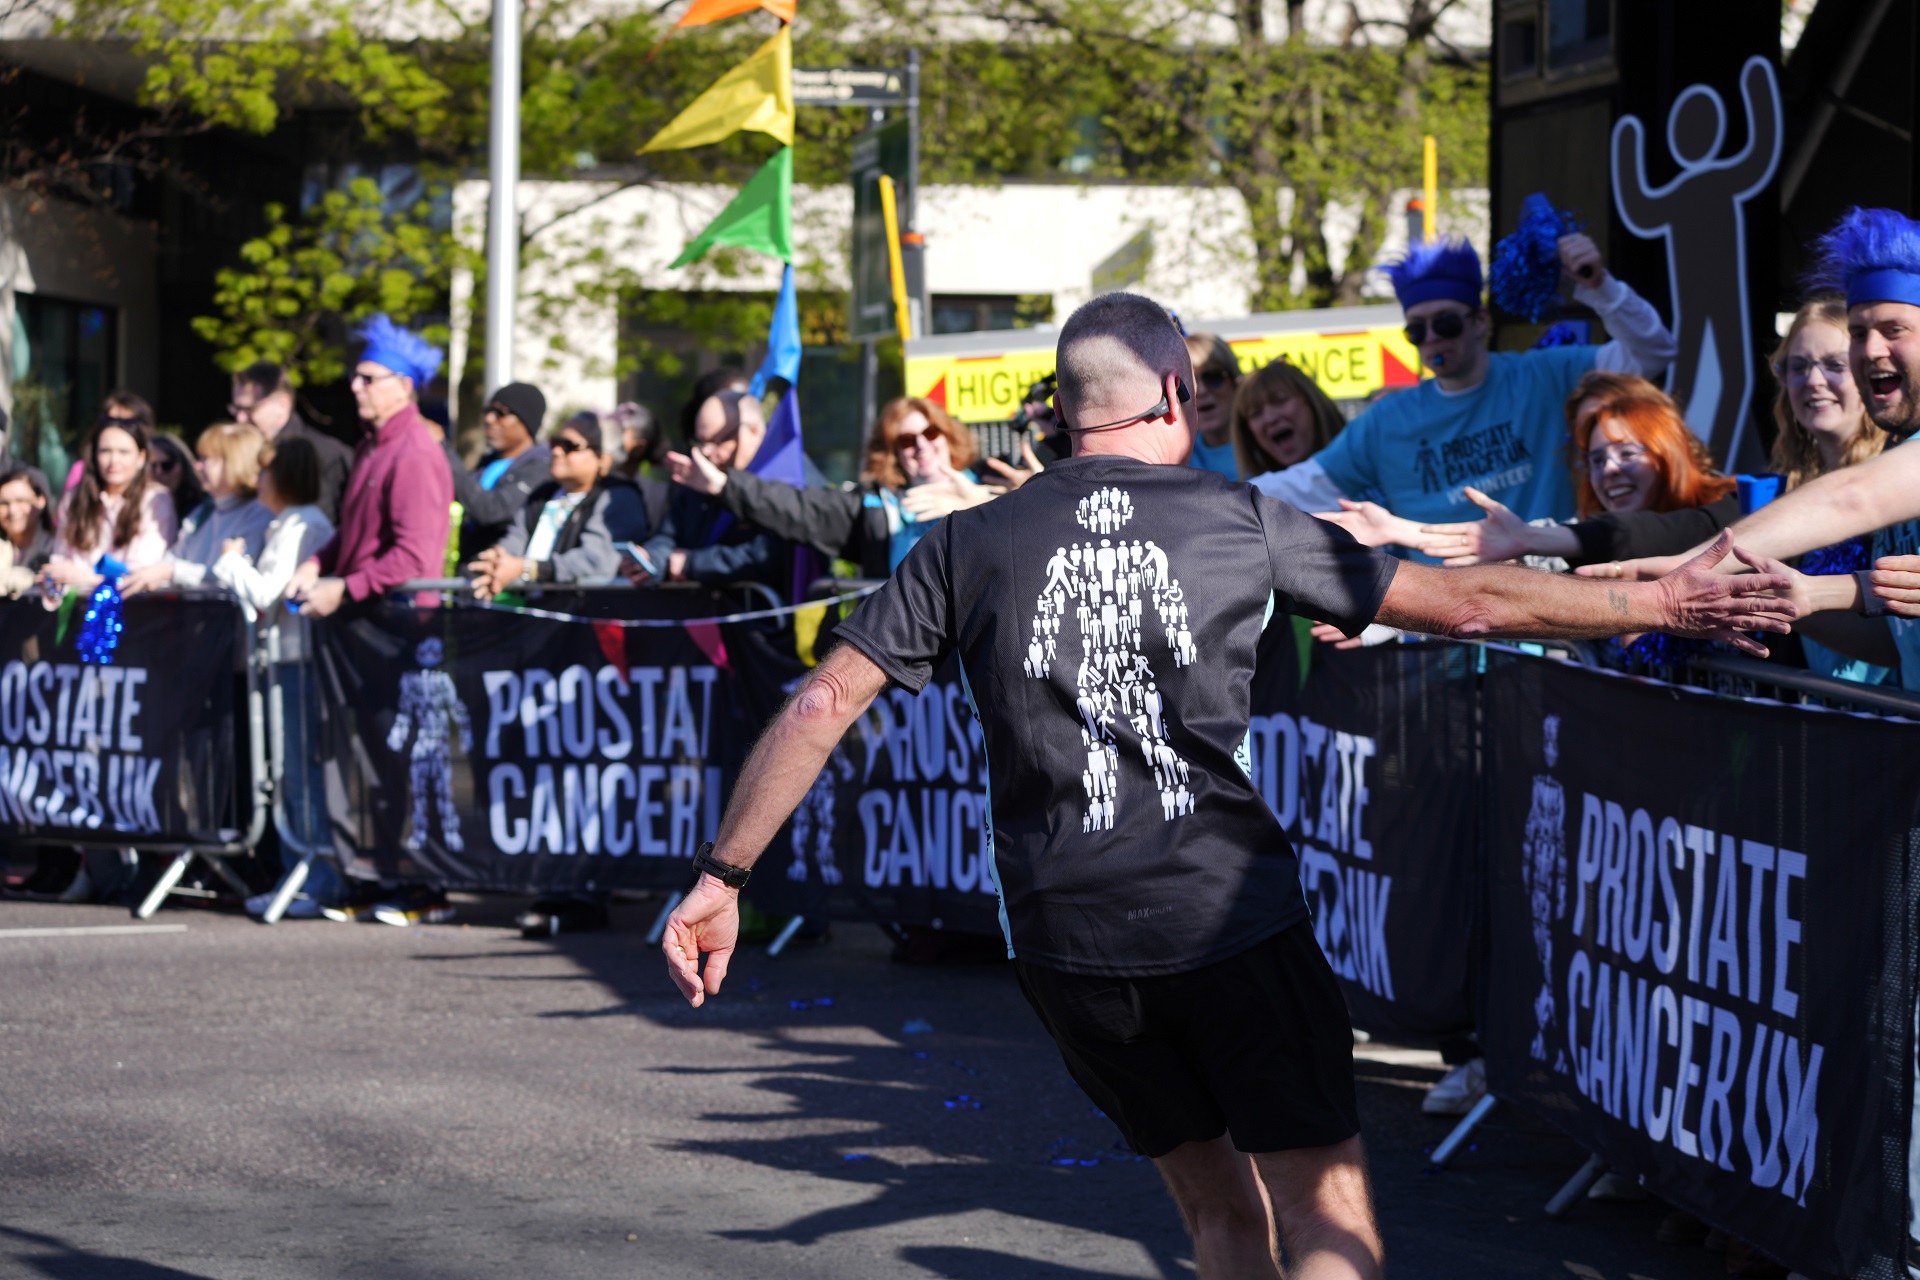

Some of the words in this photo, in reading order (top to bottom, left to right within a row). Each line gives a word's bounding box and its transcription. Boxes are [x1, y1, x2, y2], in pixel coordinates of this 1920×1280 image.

[957, 370, 1056, 407] HIGH
[1446, 463, 1533, 505] VOUNTEER
[0, 659, 148, 750] OSTATE
[482, 663, 718, 760] PROSTAT
[0, 745, 105, 829] NCER
[487, 761, 700, 858] CANCER
[1572, 792, 1808, 1019] PROSTATE
[1567, 949, 1741, 1173] CANCER
